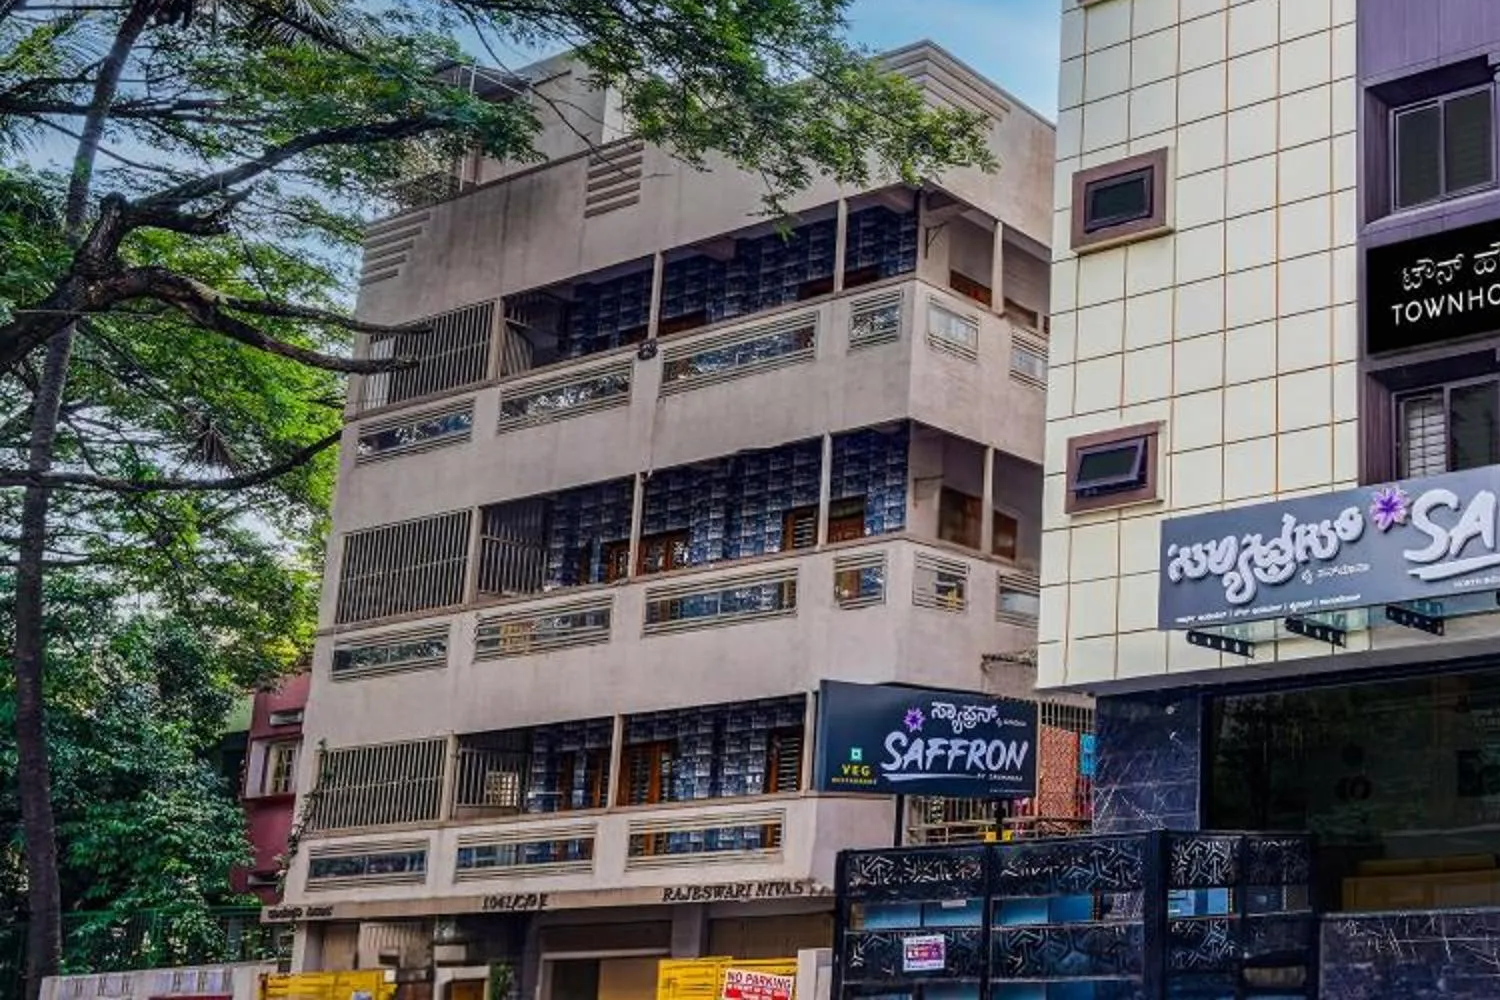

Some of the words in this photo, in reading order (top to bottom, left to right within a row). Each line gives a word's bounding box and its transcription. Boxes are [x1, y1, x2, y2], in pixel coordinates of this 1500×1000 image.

[880, 731, 1029, 771] SAFFRON
[841, 763, 871, 777] VEG
[755, 881, 804, 897] NIVAS
[727, 971, 743, 983] NO
[745, 973, 791, 989] PARKING
